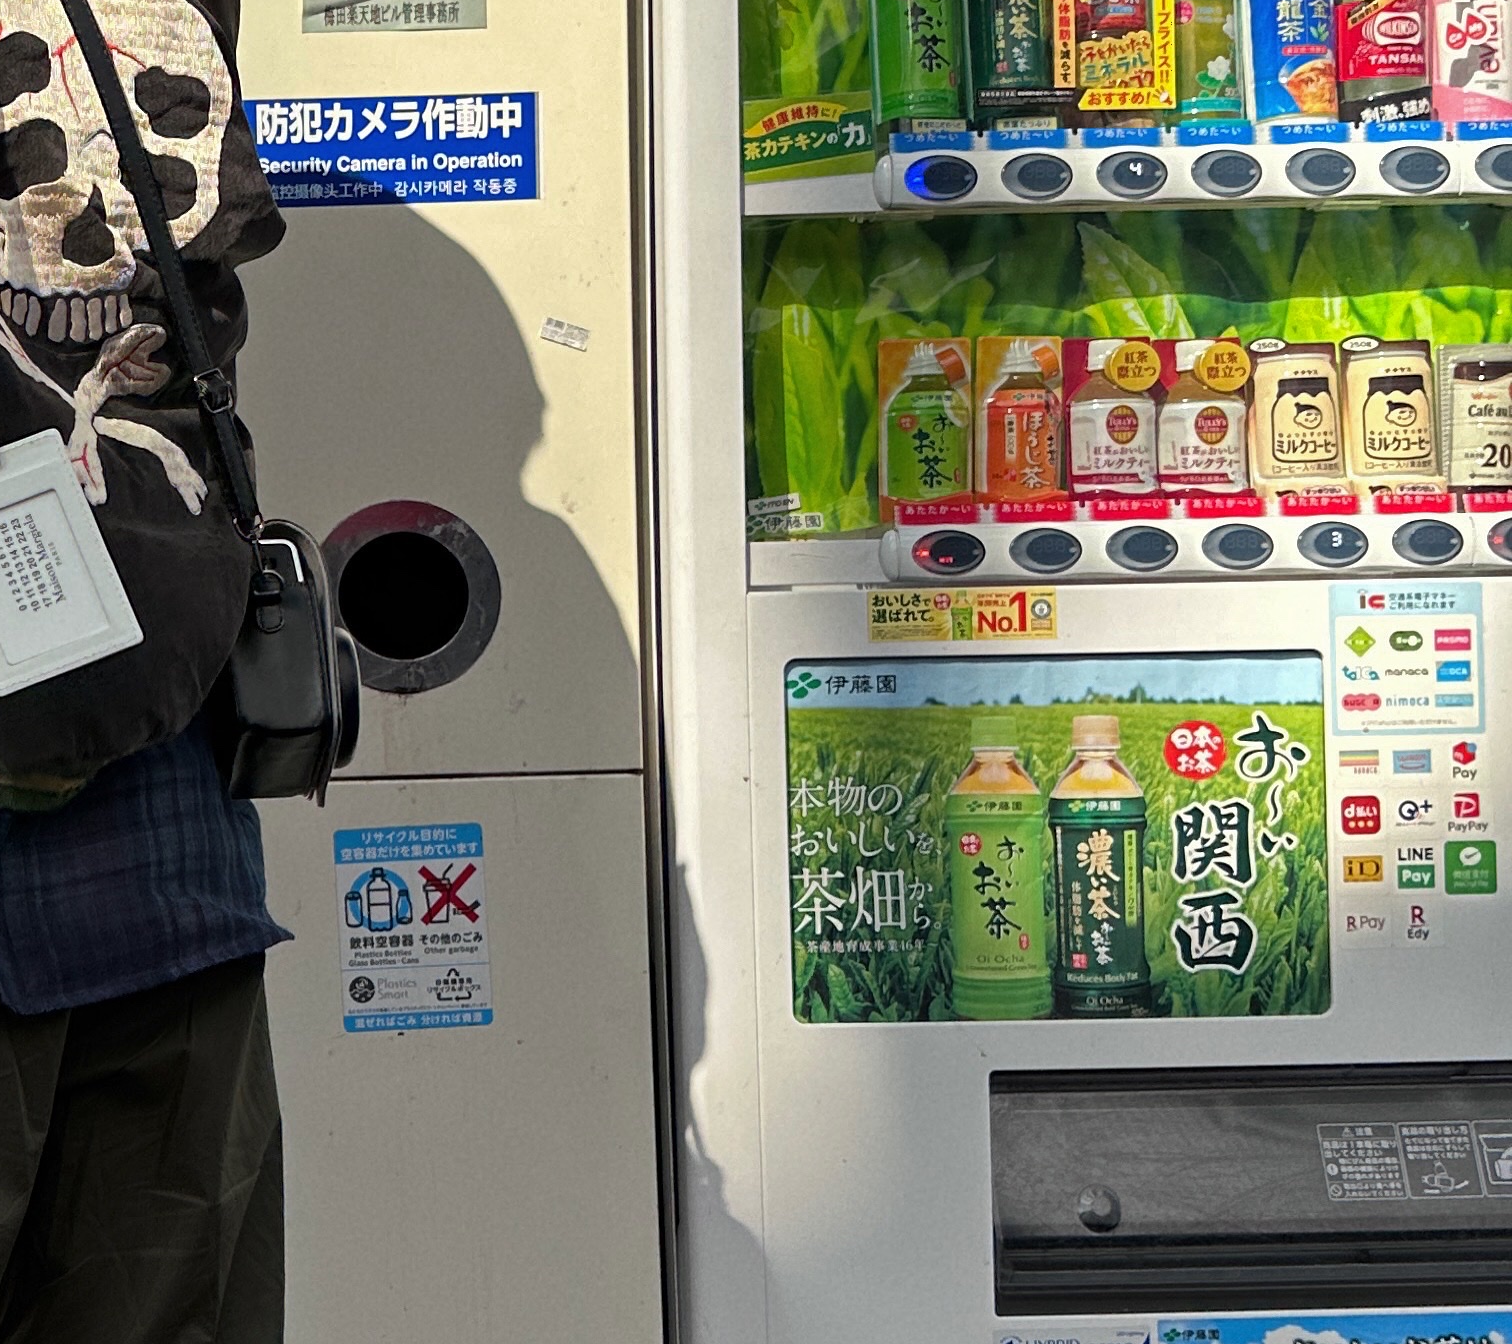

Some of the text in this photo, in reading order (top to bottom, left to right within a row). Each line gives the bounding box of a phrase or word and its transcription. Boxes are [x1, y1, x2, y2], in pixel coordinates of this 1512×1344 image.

[255, 96, 523, 145] 防犯カメラ作動中
[259, 151, 523, 177] Security Camera in Operation
[394, 176, 517, 197] 감시카메라 작동중
[1275, 439, 1337, 454] ミルクコーヒー
[1367, 436, 1431, 452] ミルクコーヒー
[763, 514, 823, 530] 伊藤園
[23, 514, 66, 604] Maison Margiela
[977, 591, 1027, 633] No.1
[824, 674, 897, 695] 伊藤園
[1385, 694, 1430, 707] nimoca
[1452, 766, 1477, 781] Pay
[789, 779, 902, 817] 本物の
[1447, 820, 1489, 833] PayPay
[1397, 847, 1434, 861] LINE
[1402, 869, 1432, 885] Pay
[1170, 796, 1258, 975] 関西
[1360, 916, 1385, 930] Pay
[419, 931, 483, 945] その他のごみ
[1407, 928, 1430, 941] Edy
